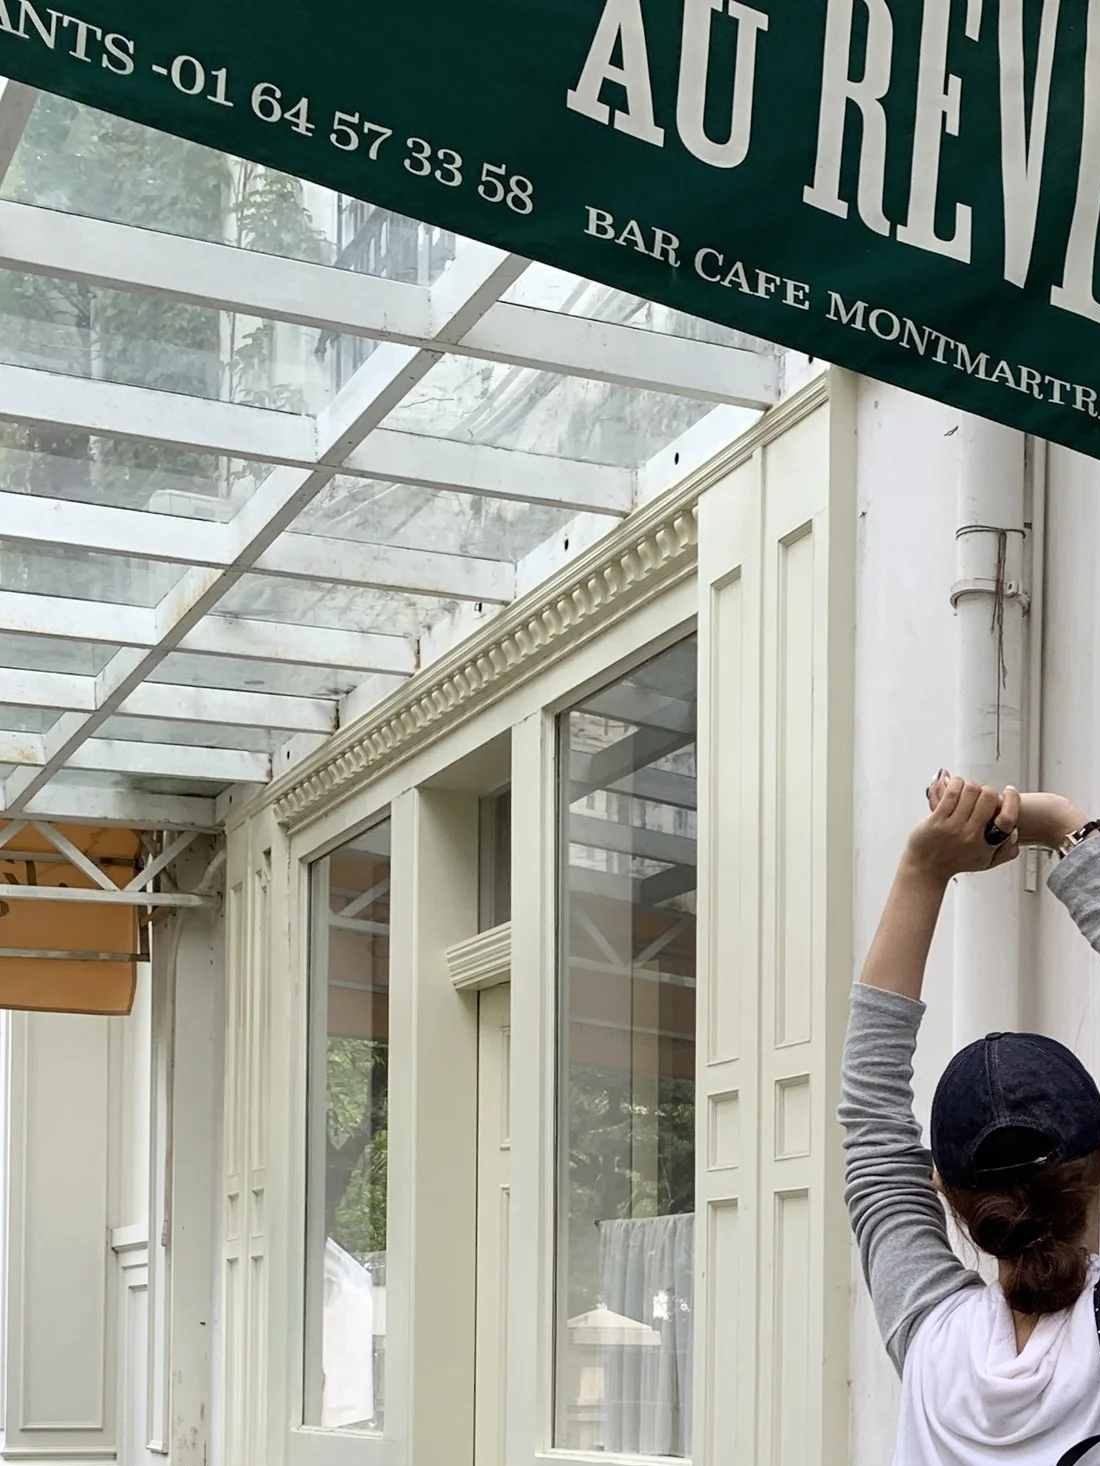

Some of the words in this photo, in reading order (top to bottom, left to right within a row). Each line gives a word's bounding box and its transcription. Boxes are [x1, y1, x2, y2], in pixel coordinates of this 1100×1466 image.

[252, 83, 316, 137] 64
[330, 111, 393, 161] 57
[404, 138, 463, 187] 33
[478, 163, 533, 215] 58
[567, 0, 768, 168] AU
[584, 206, 681, 268] BAR
[695, 248, 810, 311] CAFE
